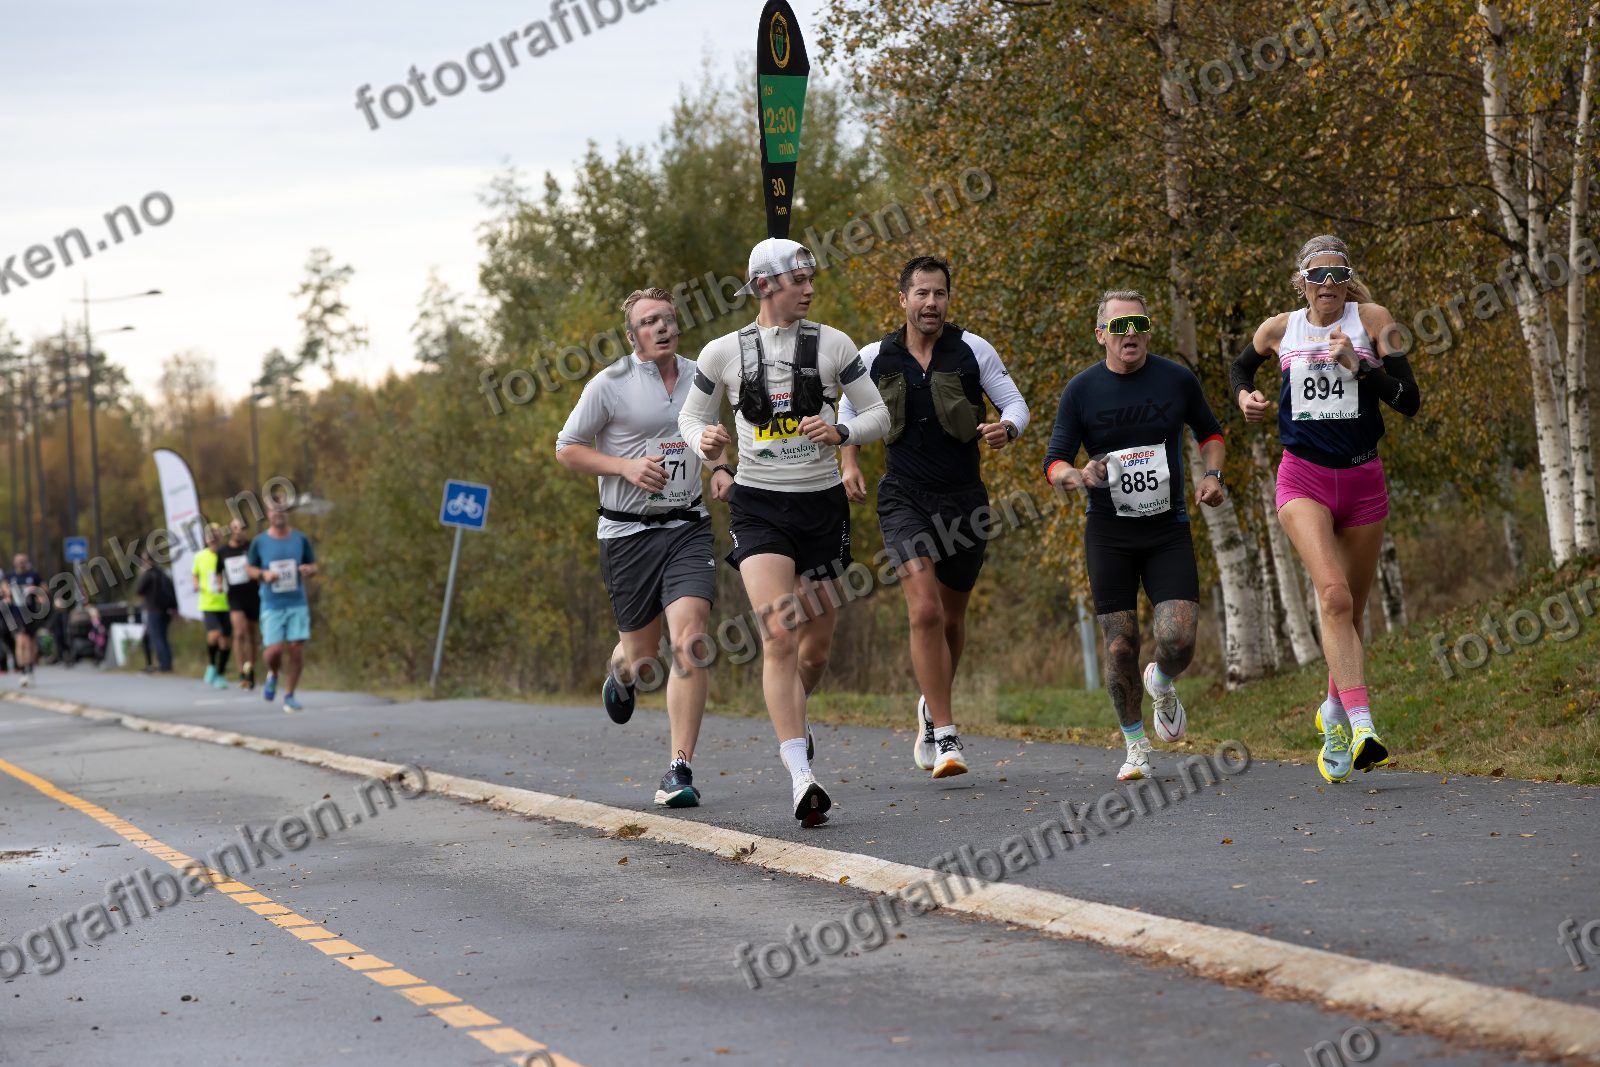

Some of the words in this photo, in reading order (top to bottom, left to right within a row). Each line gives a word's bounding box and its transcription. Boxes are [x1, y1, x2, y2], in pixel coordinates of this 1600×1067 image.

[772, 178, 785, 196] 30
[1303, 376, 1344, 400] 894
[1319, 410, 1356, 419] Aurskog
[758, 412, 801, 437] PAC
[1120, 450, 1155, 461] NORGES
[1123, 457, 1151, 468] LØPET
[1120, 470, 1159, 494] 885
